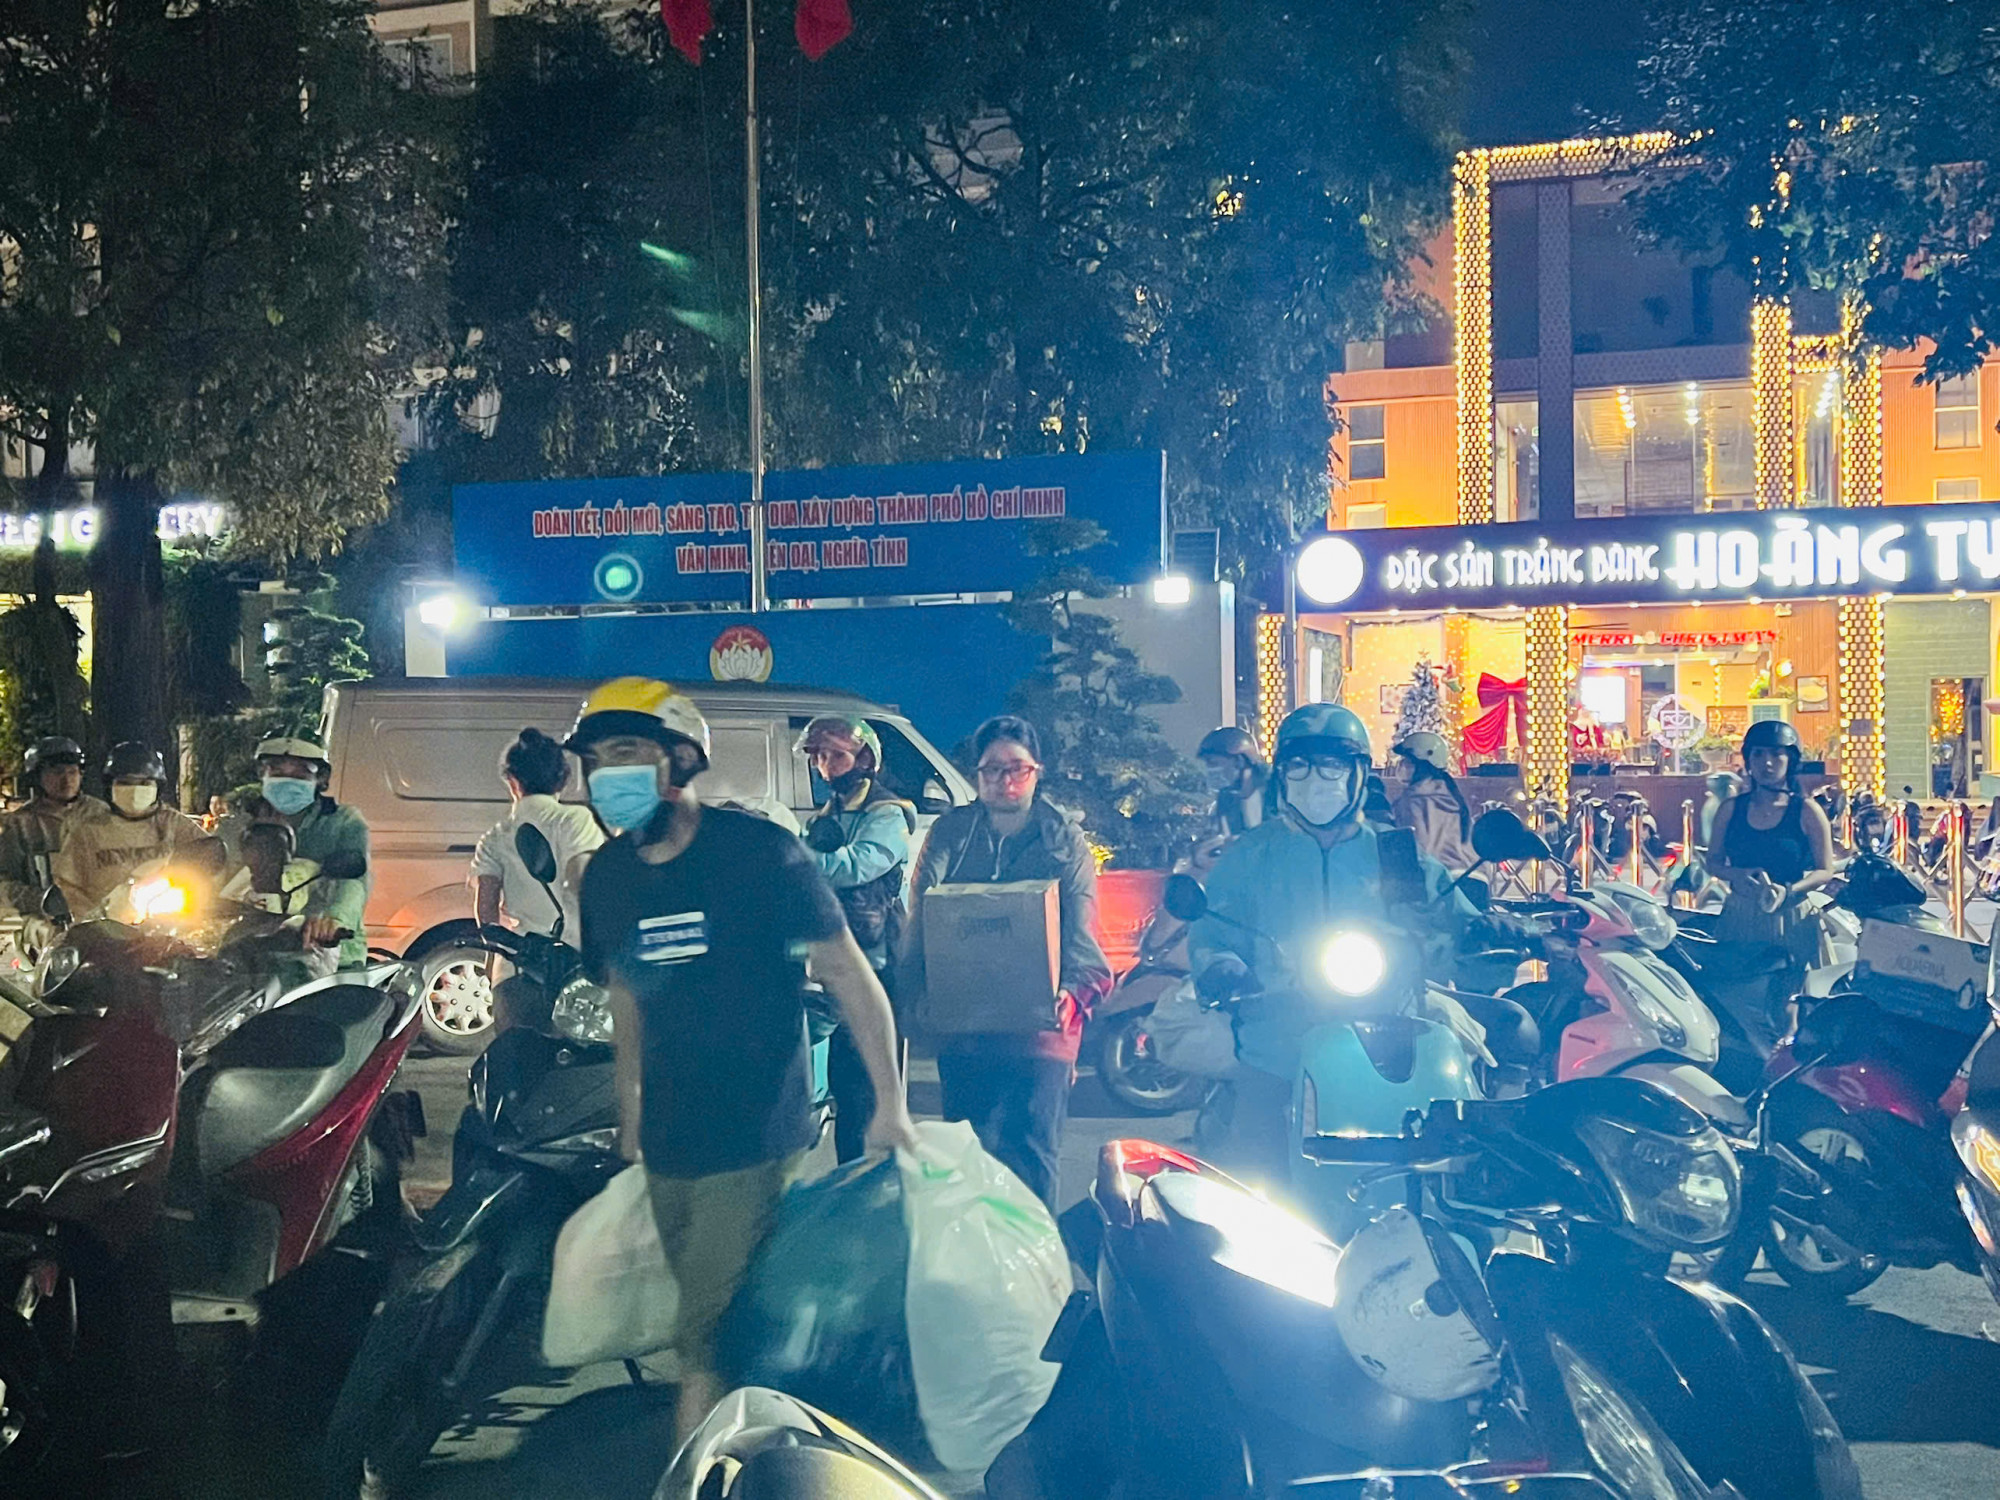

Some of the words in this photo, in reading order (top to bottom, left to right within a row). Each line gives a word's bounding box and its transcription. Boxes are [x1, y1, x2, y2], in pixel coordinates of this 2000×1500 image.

[533, 505, 572, 538] ĐOÀN
[573, 500, 602, 538] KẾT,
[603, 498, 629, 536] ĐỔI
[631, 502, 664, 537] MỚI,
[665, 501, 705, 534] SÁNG
[706, 503, 740, 536] TẠO,
[768, 500, 800, 529] ĐUA
[800, 494, 831, 528] XÂY
[831, 494, 875, 531] DỰNG
[876, 491, 928, 525] THÀNH
[929, 483, 963, 522] PHỐ
[964, 482, 988, 521] HỒ
[990, 485, 1021, 520] CHÍ
[1022, 487, 1066, 519] MINH
[675, 541, 707, 574] VĂN
[708, 543, 751, 574] MINH,
[789, 541, 820, 575] ĐẠI,
[821, 535, 870, 570] NGHĨA
[870, 534, 909, 568] TÌNH
[1387, 548, 1439, 594] ĐẶC
[1445, 540, 1494, 588] SẢN
[1501, 537, 1584, 585] TRẢNG
[1571, 632, 1636, 646] MERRY
[1660, 629, 1778, 647] CHRISTMAS
